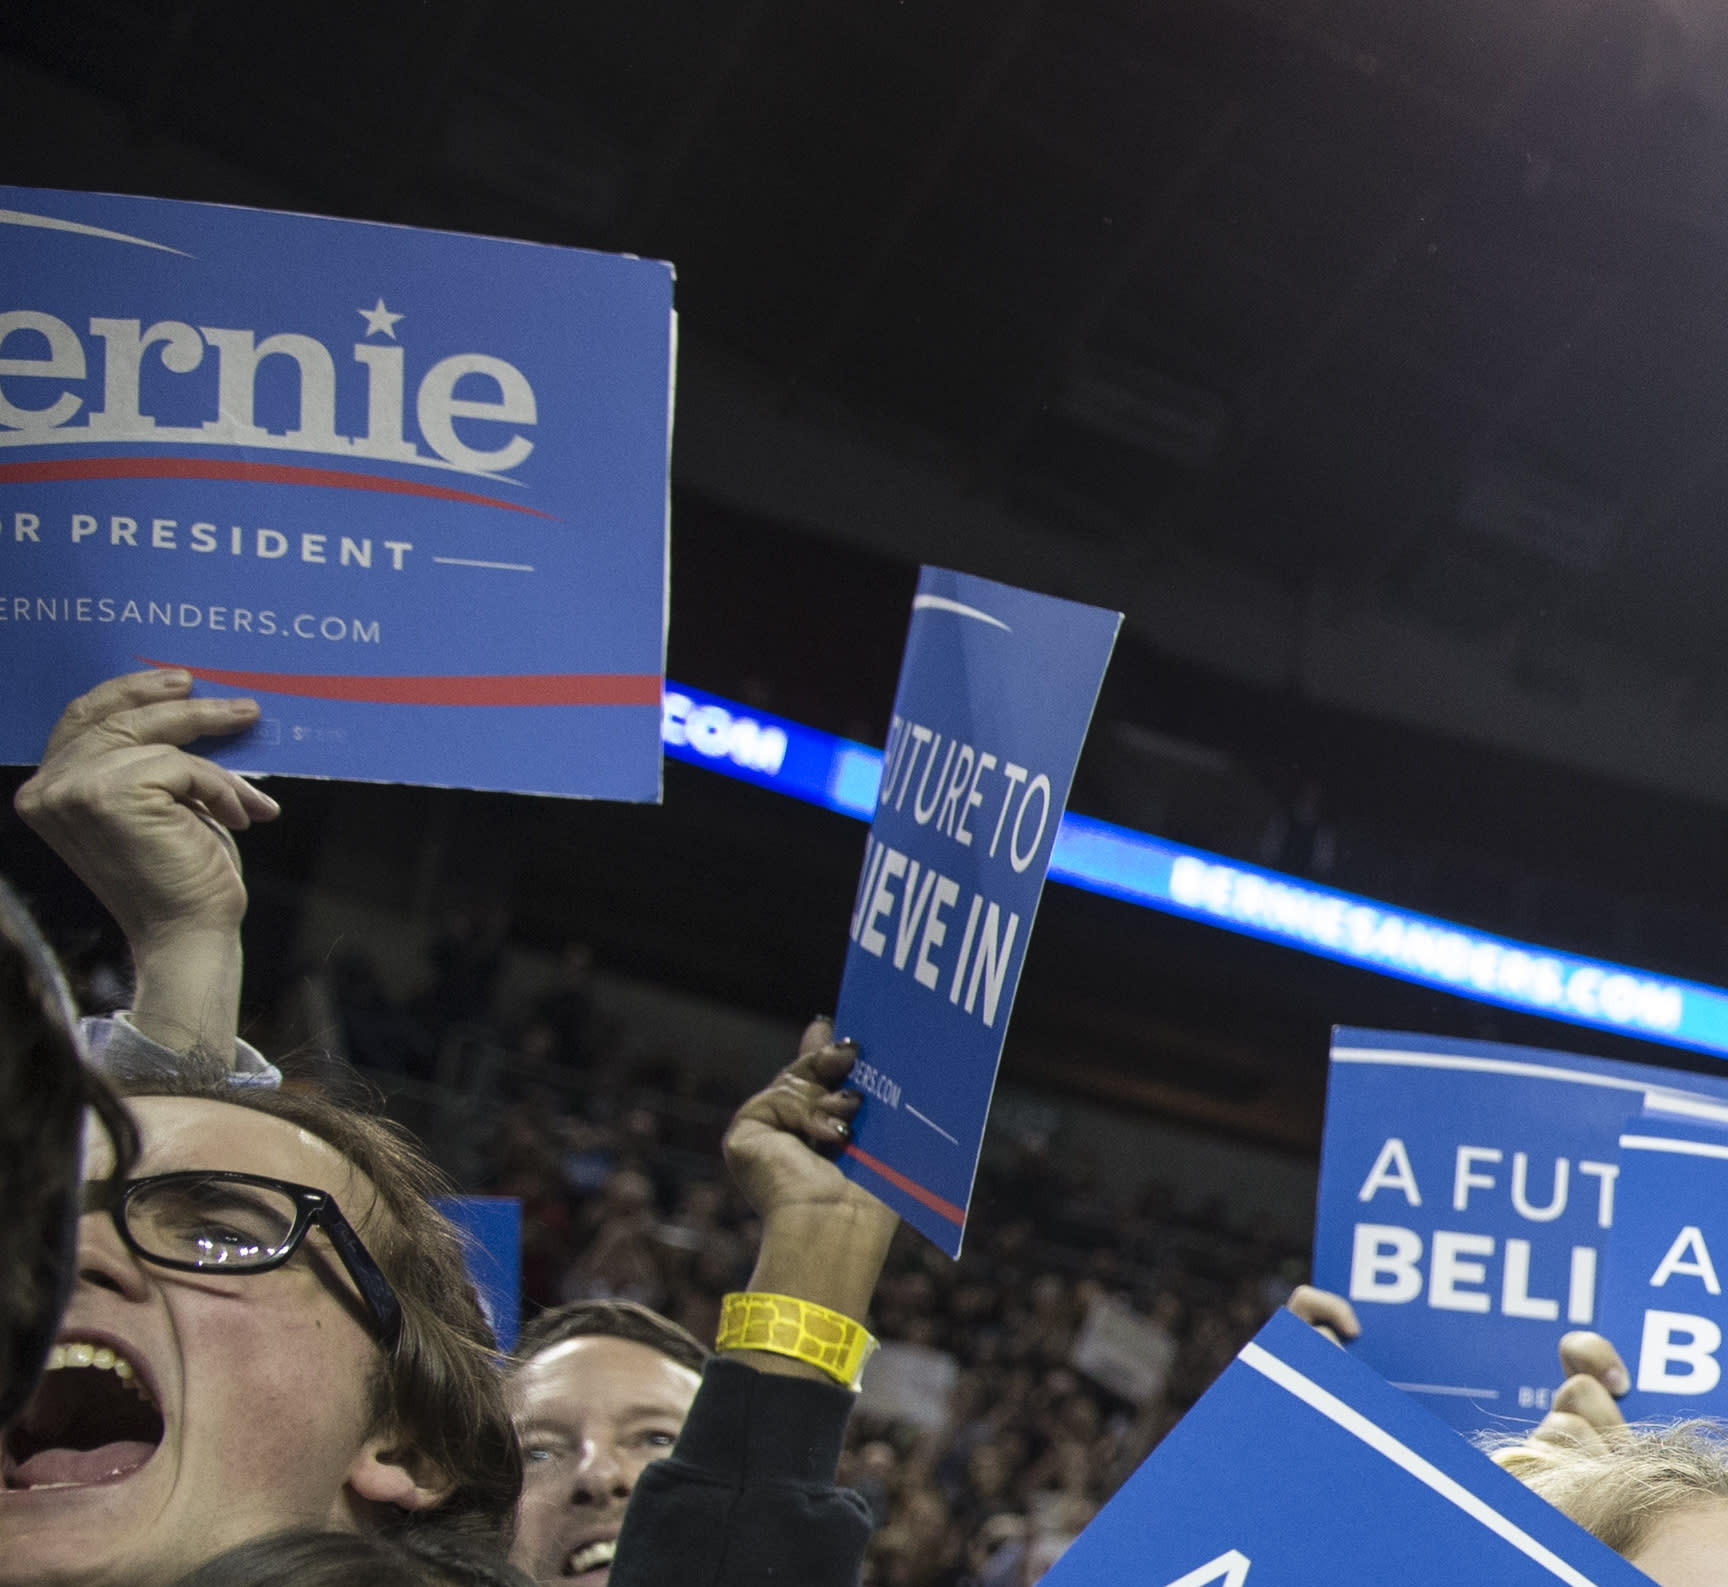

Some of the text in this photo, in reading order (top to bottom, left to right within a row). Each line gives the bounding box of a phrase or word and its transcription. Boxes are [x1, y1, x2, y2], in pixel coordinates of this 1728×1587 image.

[71, 514, 414, 570] PRESIDENT
[881, 714, 1050, 873] UTURE TO
[950, 893, 1019, 1028] IN
[1170, 856, 1683, 1033] BERNIESANDERS.COM
[1358, 1137, 1422, 1207] A
[1350, 1223, 1597, 1325] BELI
[1649, 1226, 1721, 1295] A
